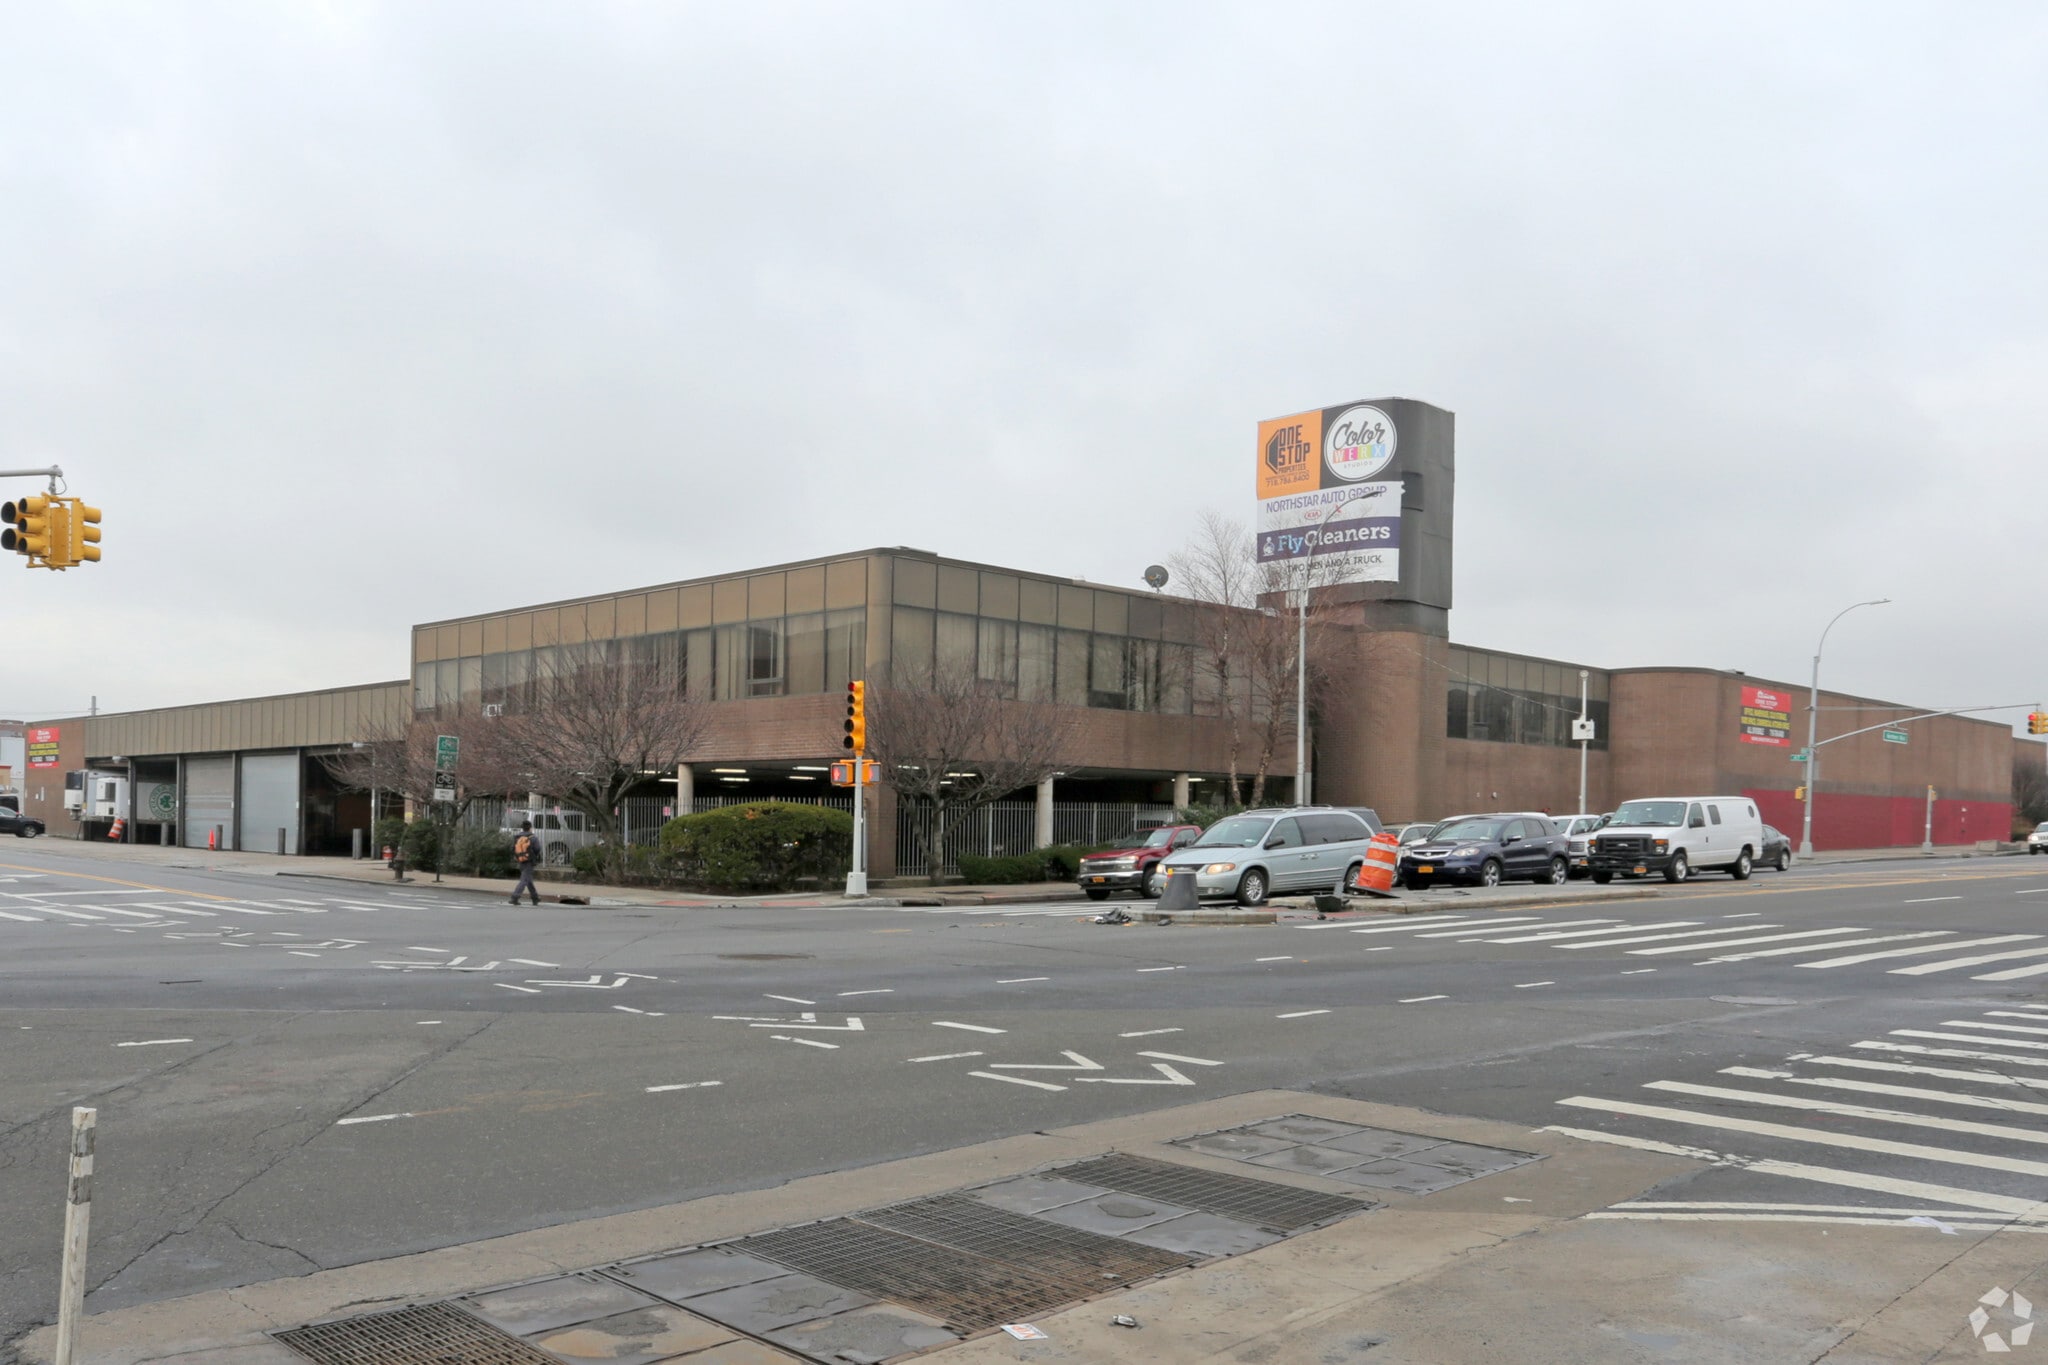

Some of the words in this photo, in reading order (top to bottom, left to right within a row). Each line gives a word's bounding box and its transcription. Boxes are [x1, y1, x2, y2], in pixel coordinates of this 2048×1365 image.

[1280, 424, 1303, 446] ONE
[1333, 421, 1385, 450] Color
[1279, 442, 1310, 467] STOP
[1333, 444, 1385, 463] WERX
[1266, 494, 1319, 513] NORTHSTAR
[1321, 489, 1346, 505] AUTO
[1348, 485, 1388, 501] GROUP
[1353, 555, 1383, 565] TRUCK
